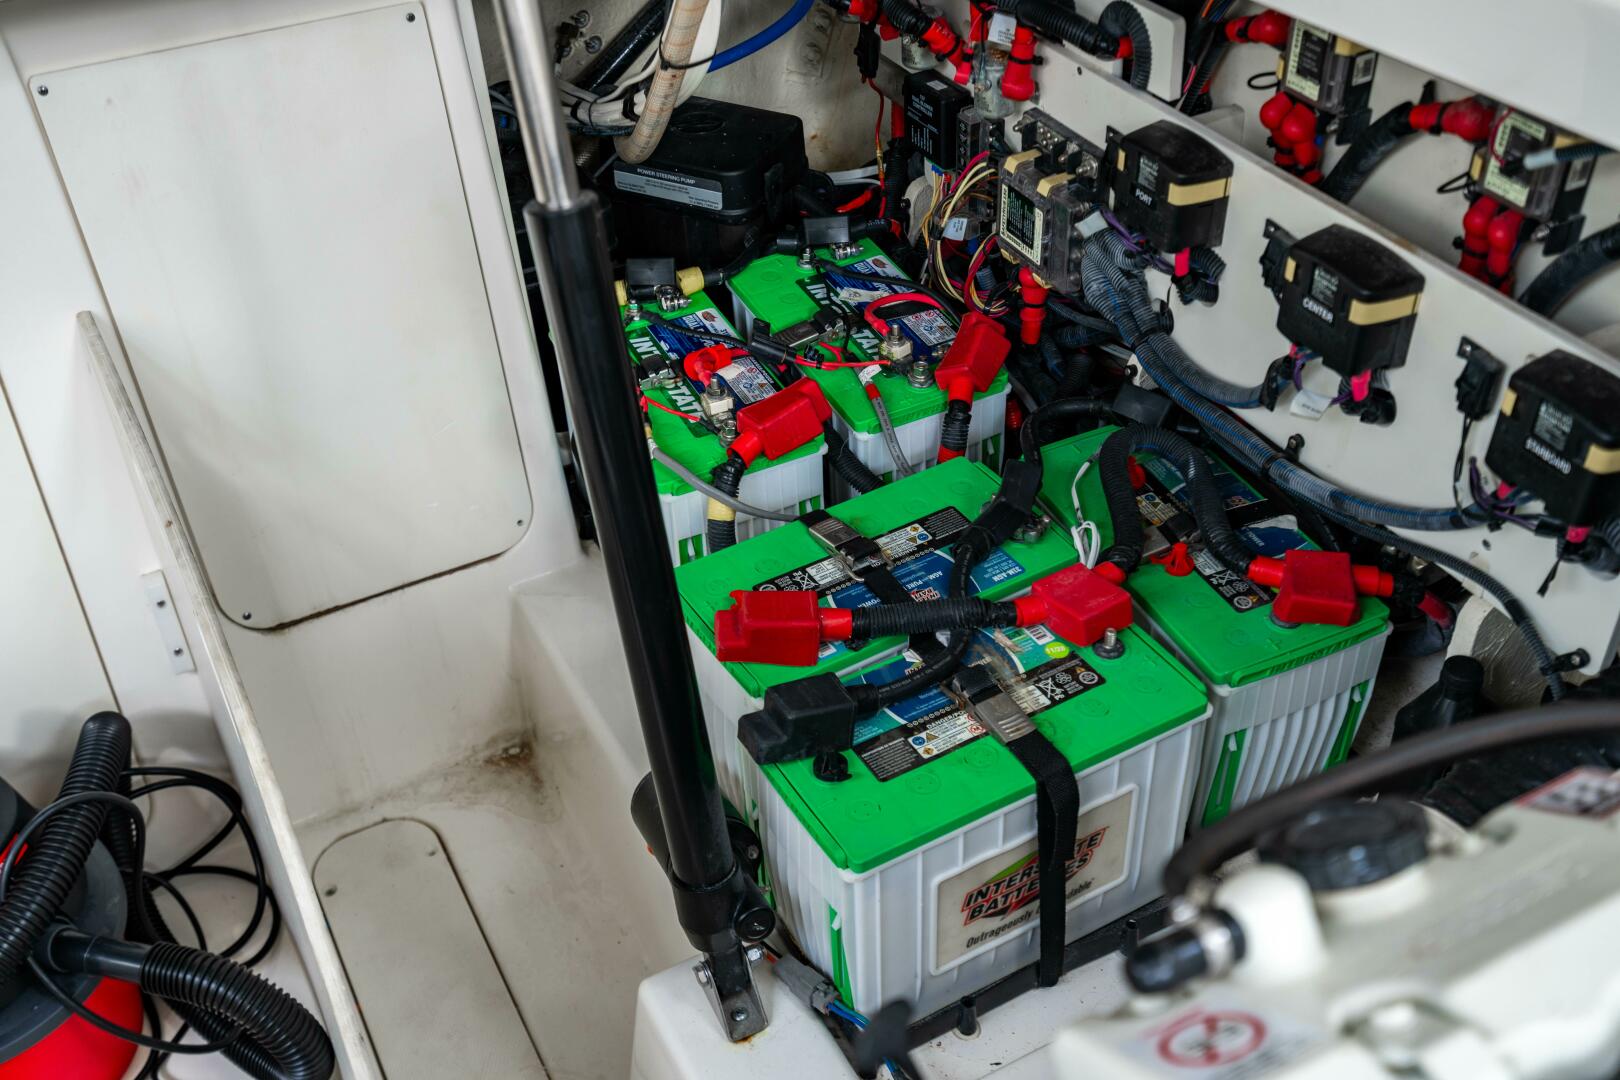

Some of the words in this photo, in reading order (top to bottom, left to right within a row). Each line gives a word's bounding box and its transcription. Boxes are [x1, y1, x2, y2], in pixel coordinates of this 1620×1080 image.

[1135, 189, 1153, 205] PORT
[1302, 297, 1334, 324] CENTER
[966, 909, 1034, 949] Outrageously
